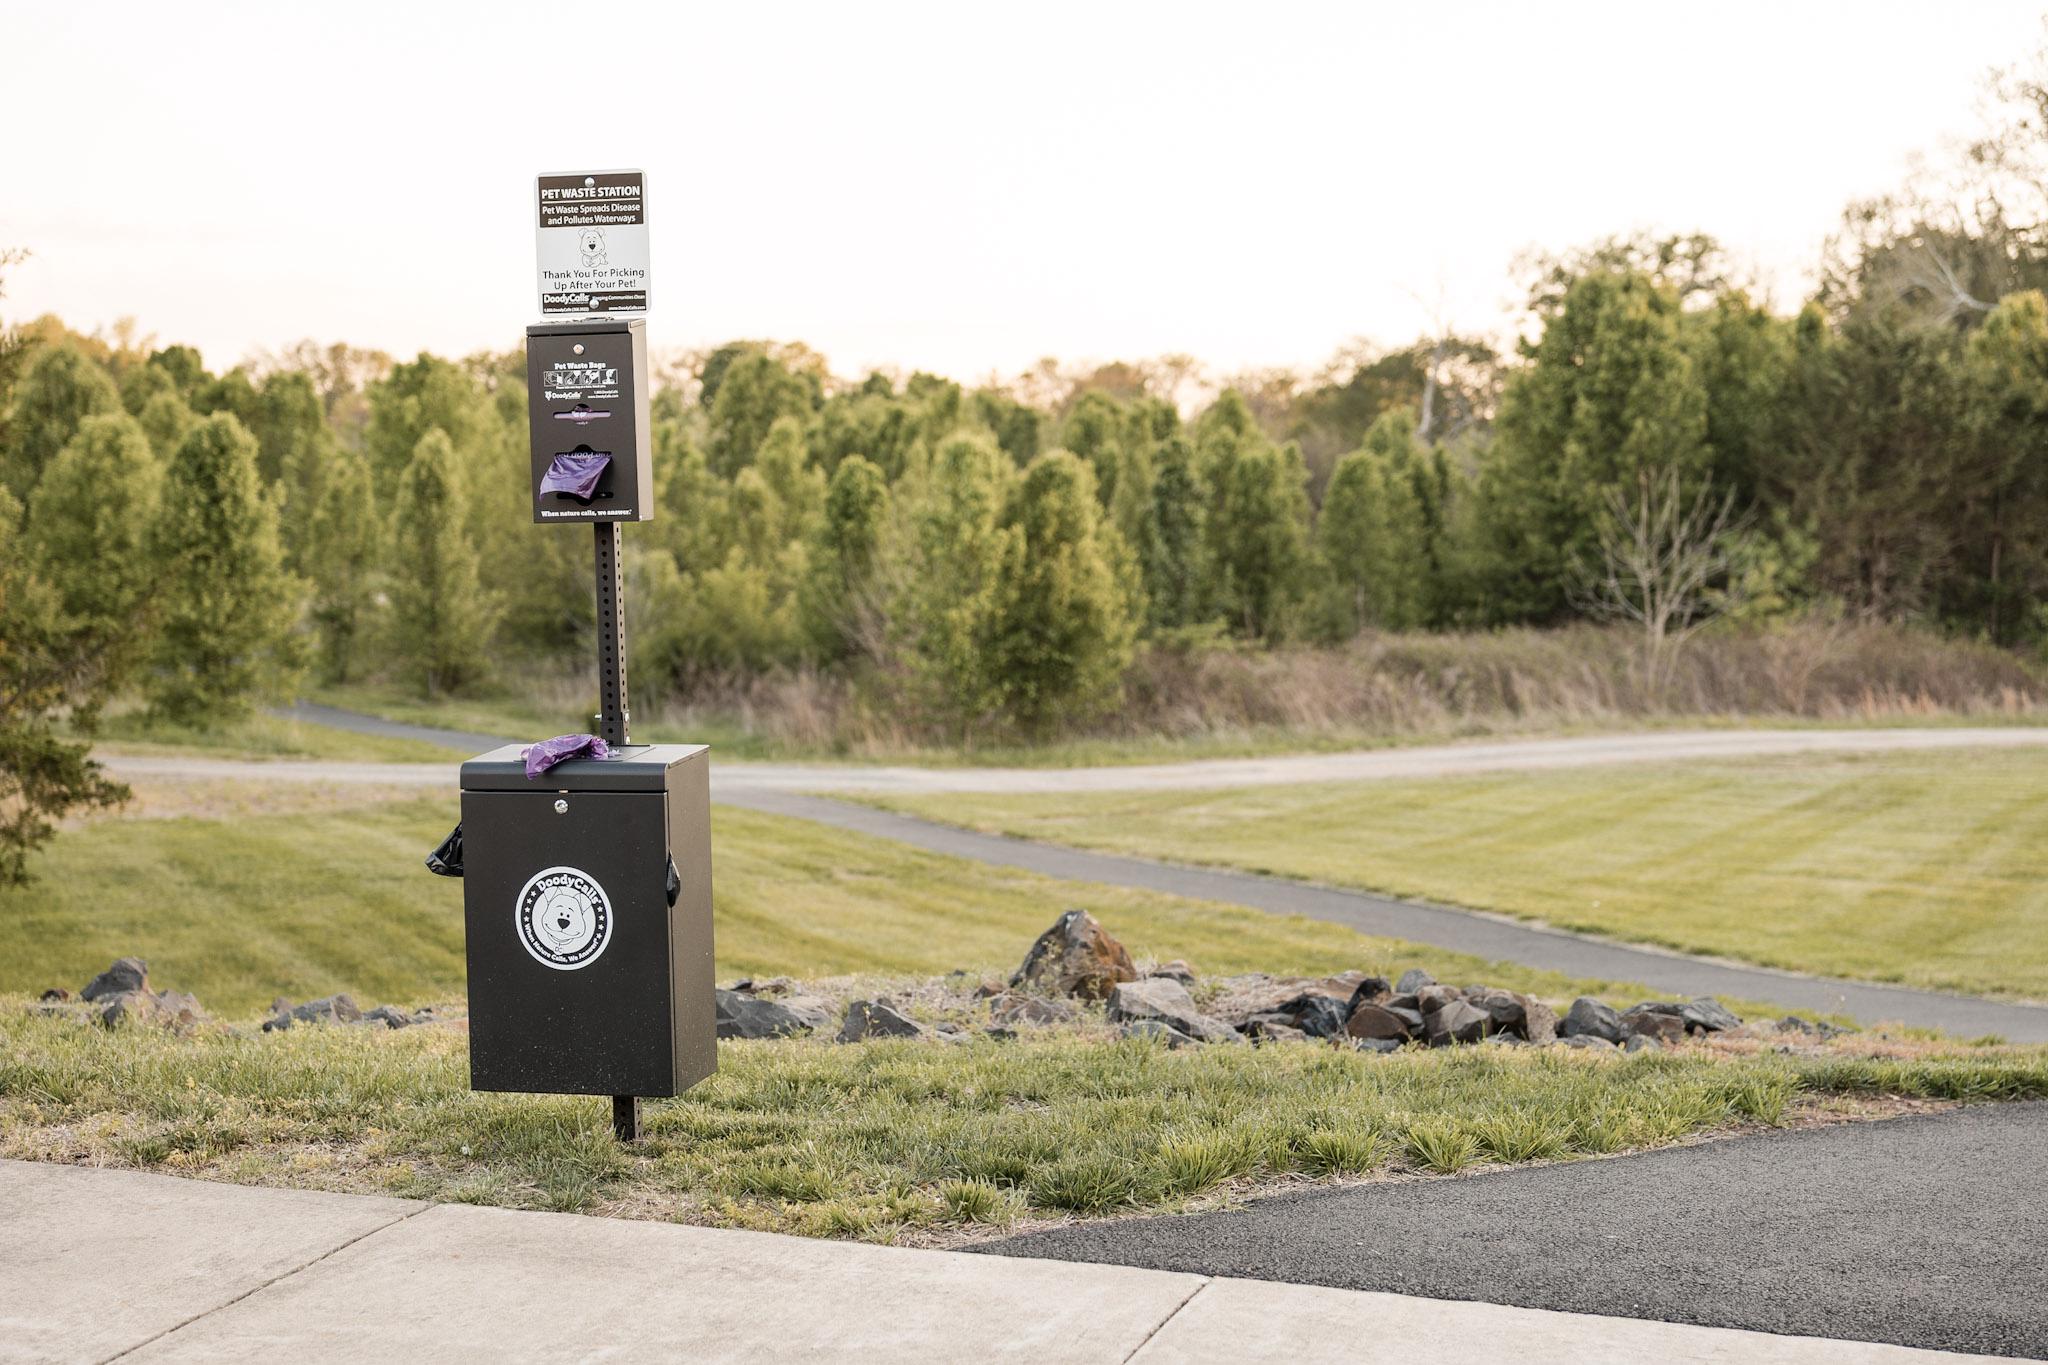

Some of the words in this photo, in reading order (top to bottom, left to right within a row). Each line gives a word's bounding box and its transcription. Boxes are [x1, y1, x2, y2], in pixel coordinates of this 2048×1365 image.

[541, 189, 560, 199] PET
[561, 187, 596, 198] WASTE
[597, 185, 640, 197] STATION
[542, 206, 555, 215] Pet
[555, 205, 579, 214] Waste
[580, 203, 610, 214] Spreads
[611, 203, 640, 212] Disease
[547, 216, 562, 225] and
[563, 215, 594, 224] Pollutes
[594, 214, 636, 225] Waterways
[543, 270, 572, 279] Thank
[573, 270, 590, 278] You
[592, 269, 607, 277] For
[610, 268, 645, 279] Picking
[554, 282, 567, 291] Up
[569, 281, 593, 290] After
[595, 280, 616, 288] Your
[618, 279, 636, 288] Pet!
[544, 293, 590, 305] DoodyCalls
[554, 362, 567, 370] Pet
[566, 362, 588, 370] Waste
[588, 361, 606, 370] Bags
[552, 391, 581, 400] DoodyCalls
[580, 509, 598, 517] calls,
[535, 874, 600, 905] DoodyCalls
[524, 923, 536, 943] When
[532, 941, 551, 959] Nature
[550, 954, 568, 963] Calls,
[567, 954, 579, 962] We
